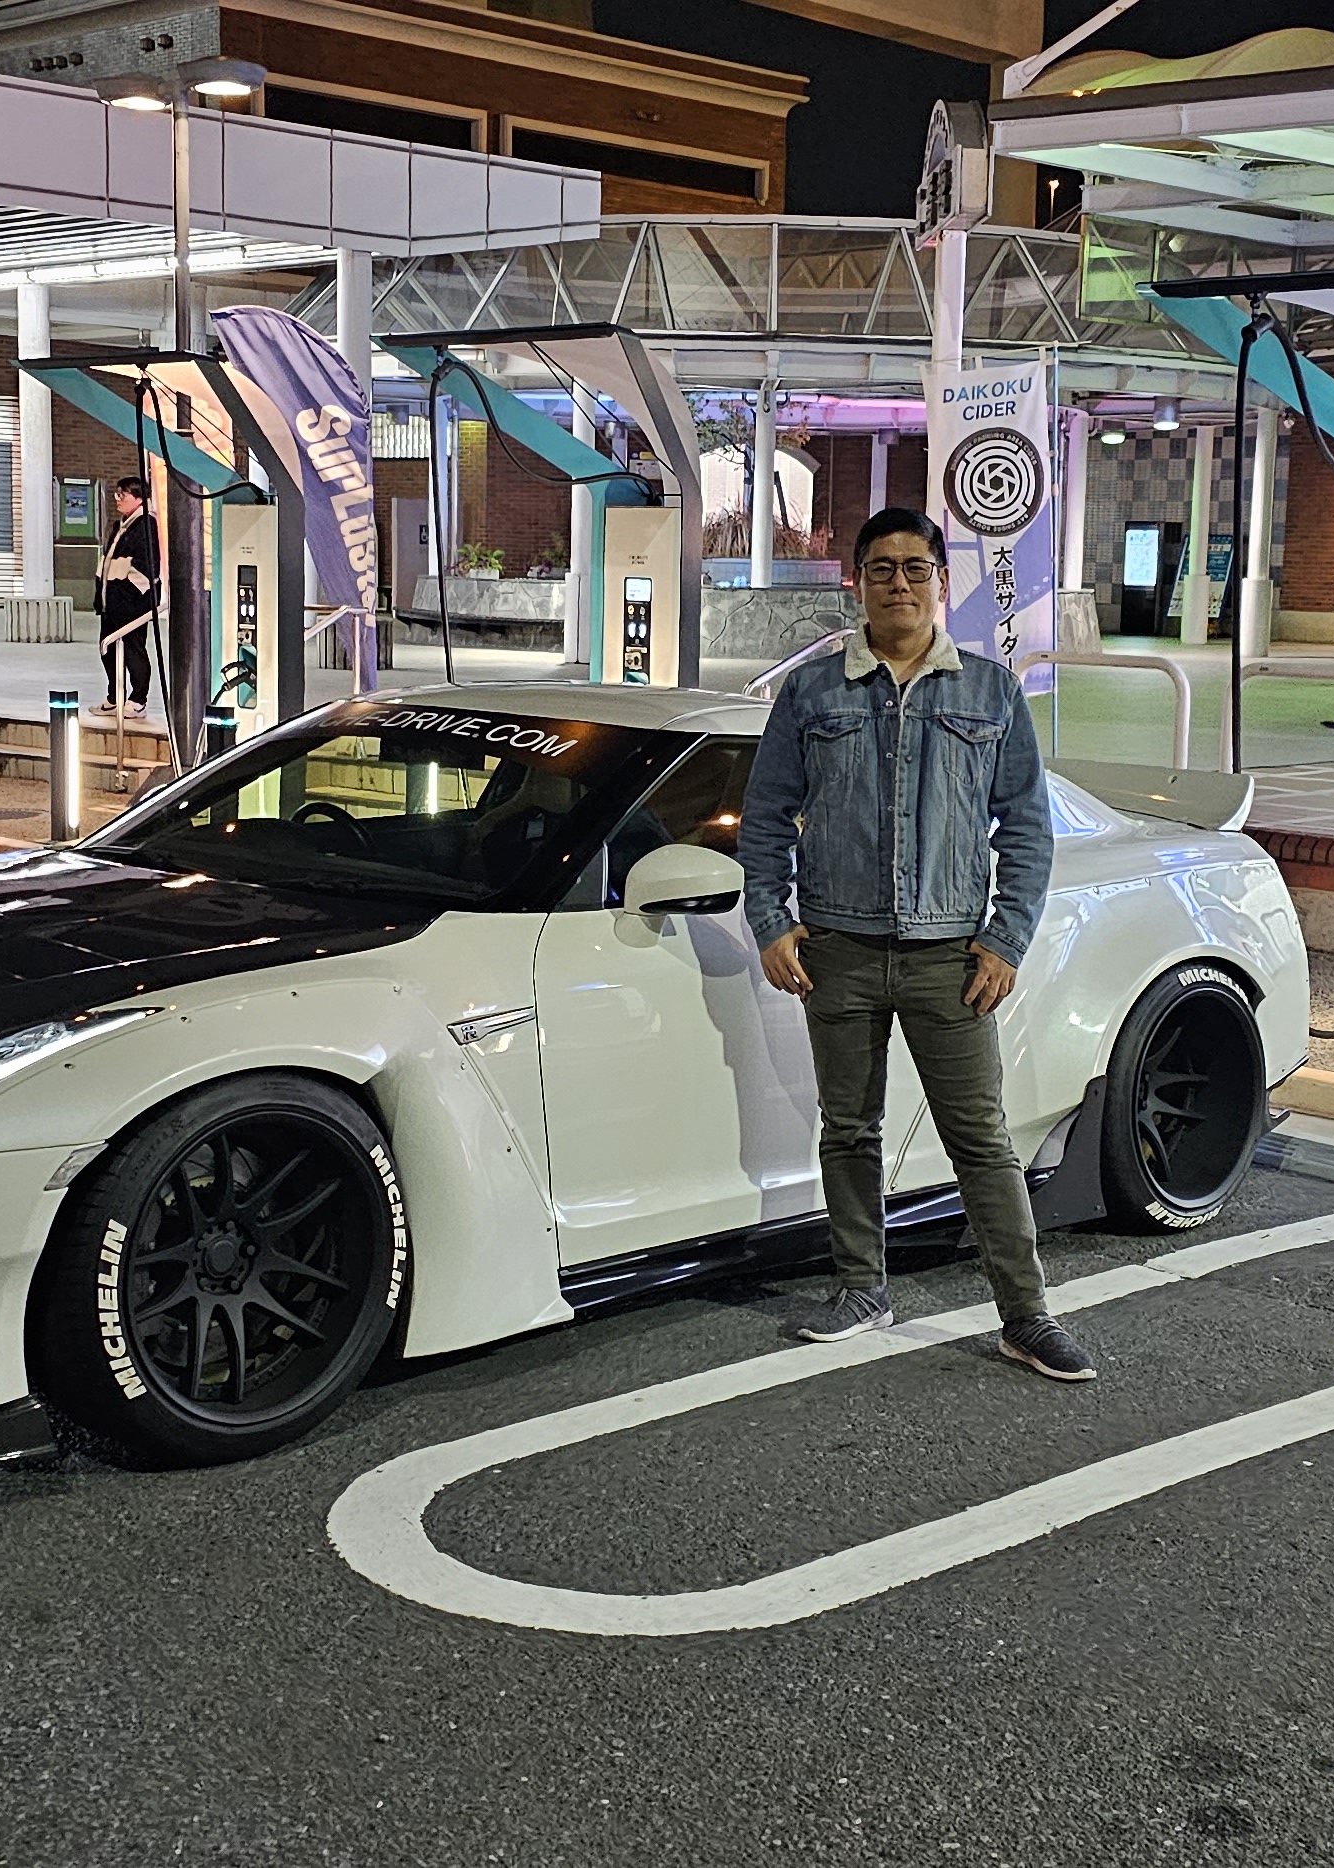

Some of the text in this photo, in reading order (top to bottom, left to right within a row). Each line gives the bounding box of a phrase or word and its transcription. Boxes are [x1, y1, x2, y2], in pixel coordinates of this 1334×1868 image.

[943, 377, 1033, 403] DAIKOKU
[962, 401, 1016, 421] CIDER
[992, 546, 1019, 671] 大黒サイダー
[301, 709, 578, 757] ICHE-DRIVE.COM
[369, 1144, 407, 1309] MICHELIN
[97, 1219, 147, 1399] MICHELIN
